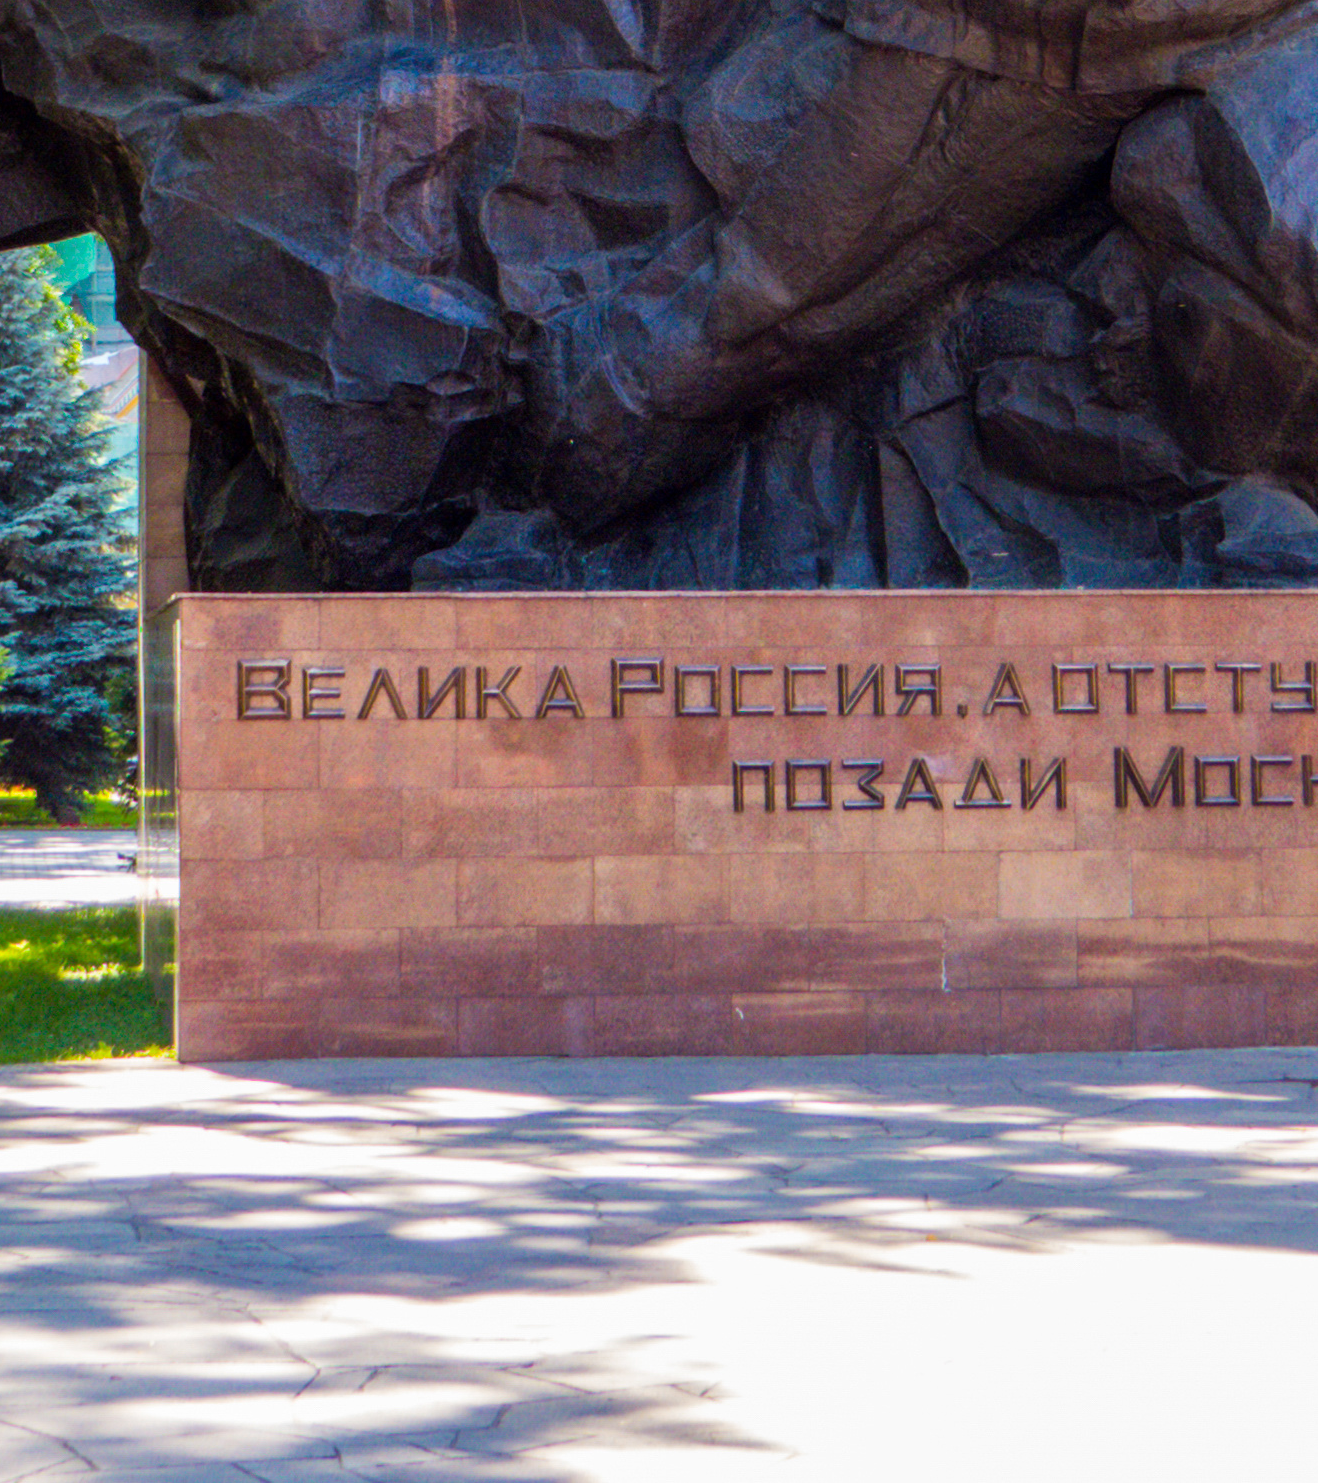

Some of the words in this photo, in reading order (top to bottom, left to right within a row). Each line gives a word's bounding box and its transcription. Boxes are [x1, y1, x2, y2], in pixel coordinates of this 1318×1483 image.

[237, 658, 585, 720] ВЕЛИКА
[983, 662, 1031, 716] А
[732, 758, 1067, 814] ПОЗАДИ
